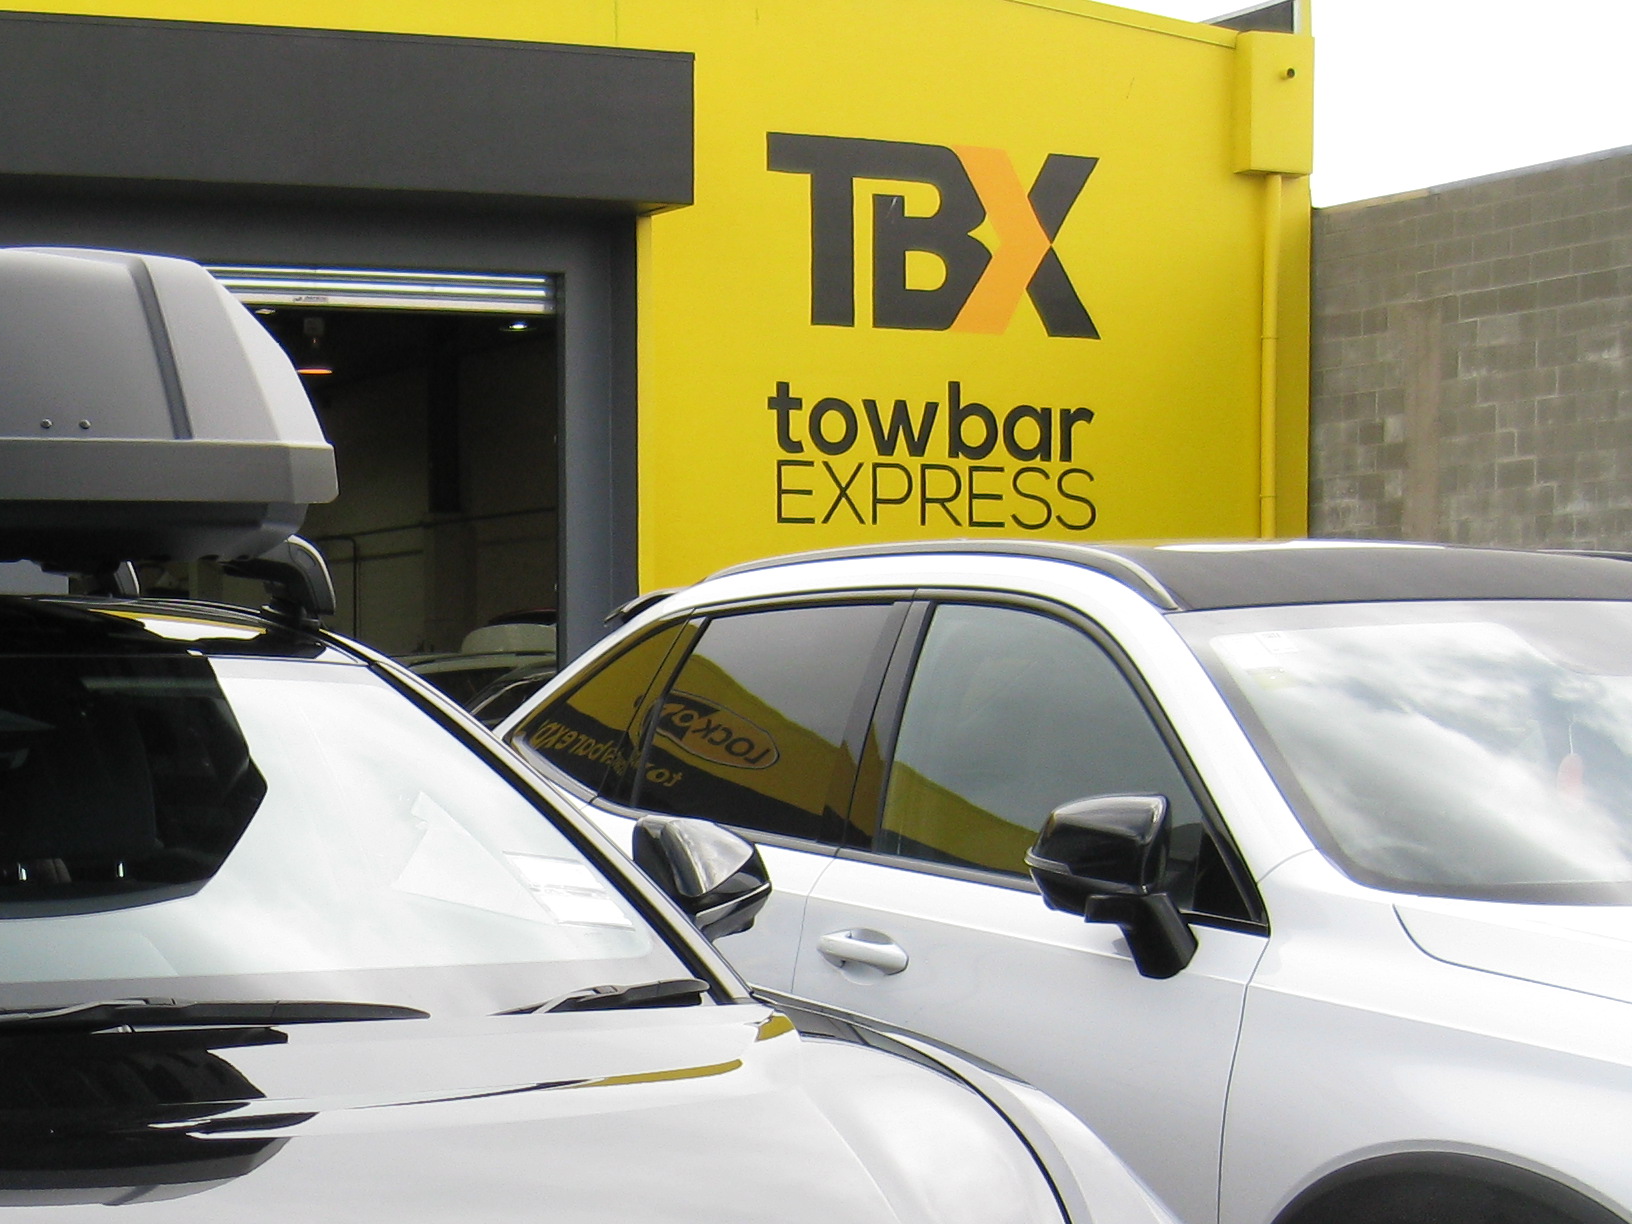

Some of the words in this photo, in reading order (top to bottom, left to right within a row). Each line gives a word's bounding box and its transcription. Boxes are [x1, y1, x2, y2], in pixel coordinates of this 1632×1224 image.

[766, 131, 1101, 340] TBX
[767, 381, 1095, 463] towbar
[775, 459, 1098, 531] EXPRESS
